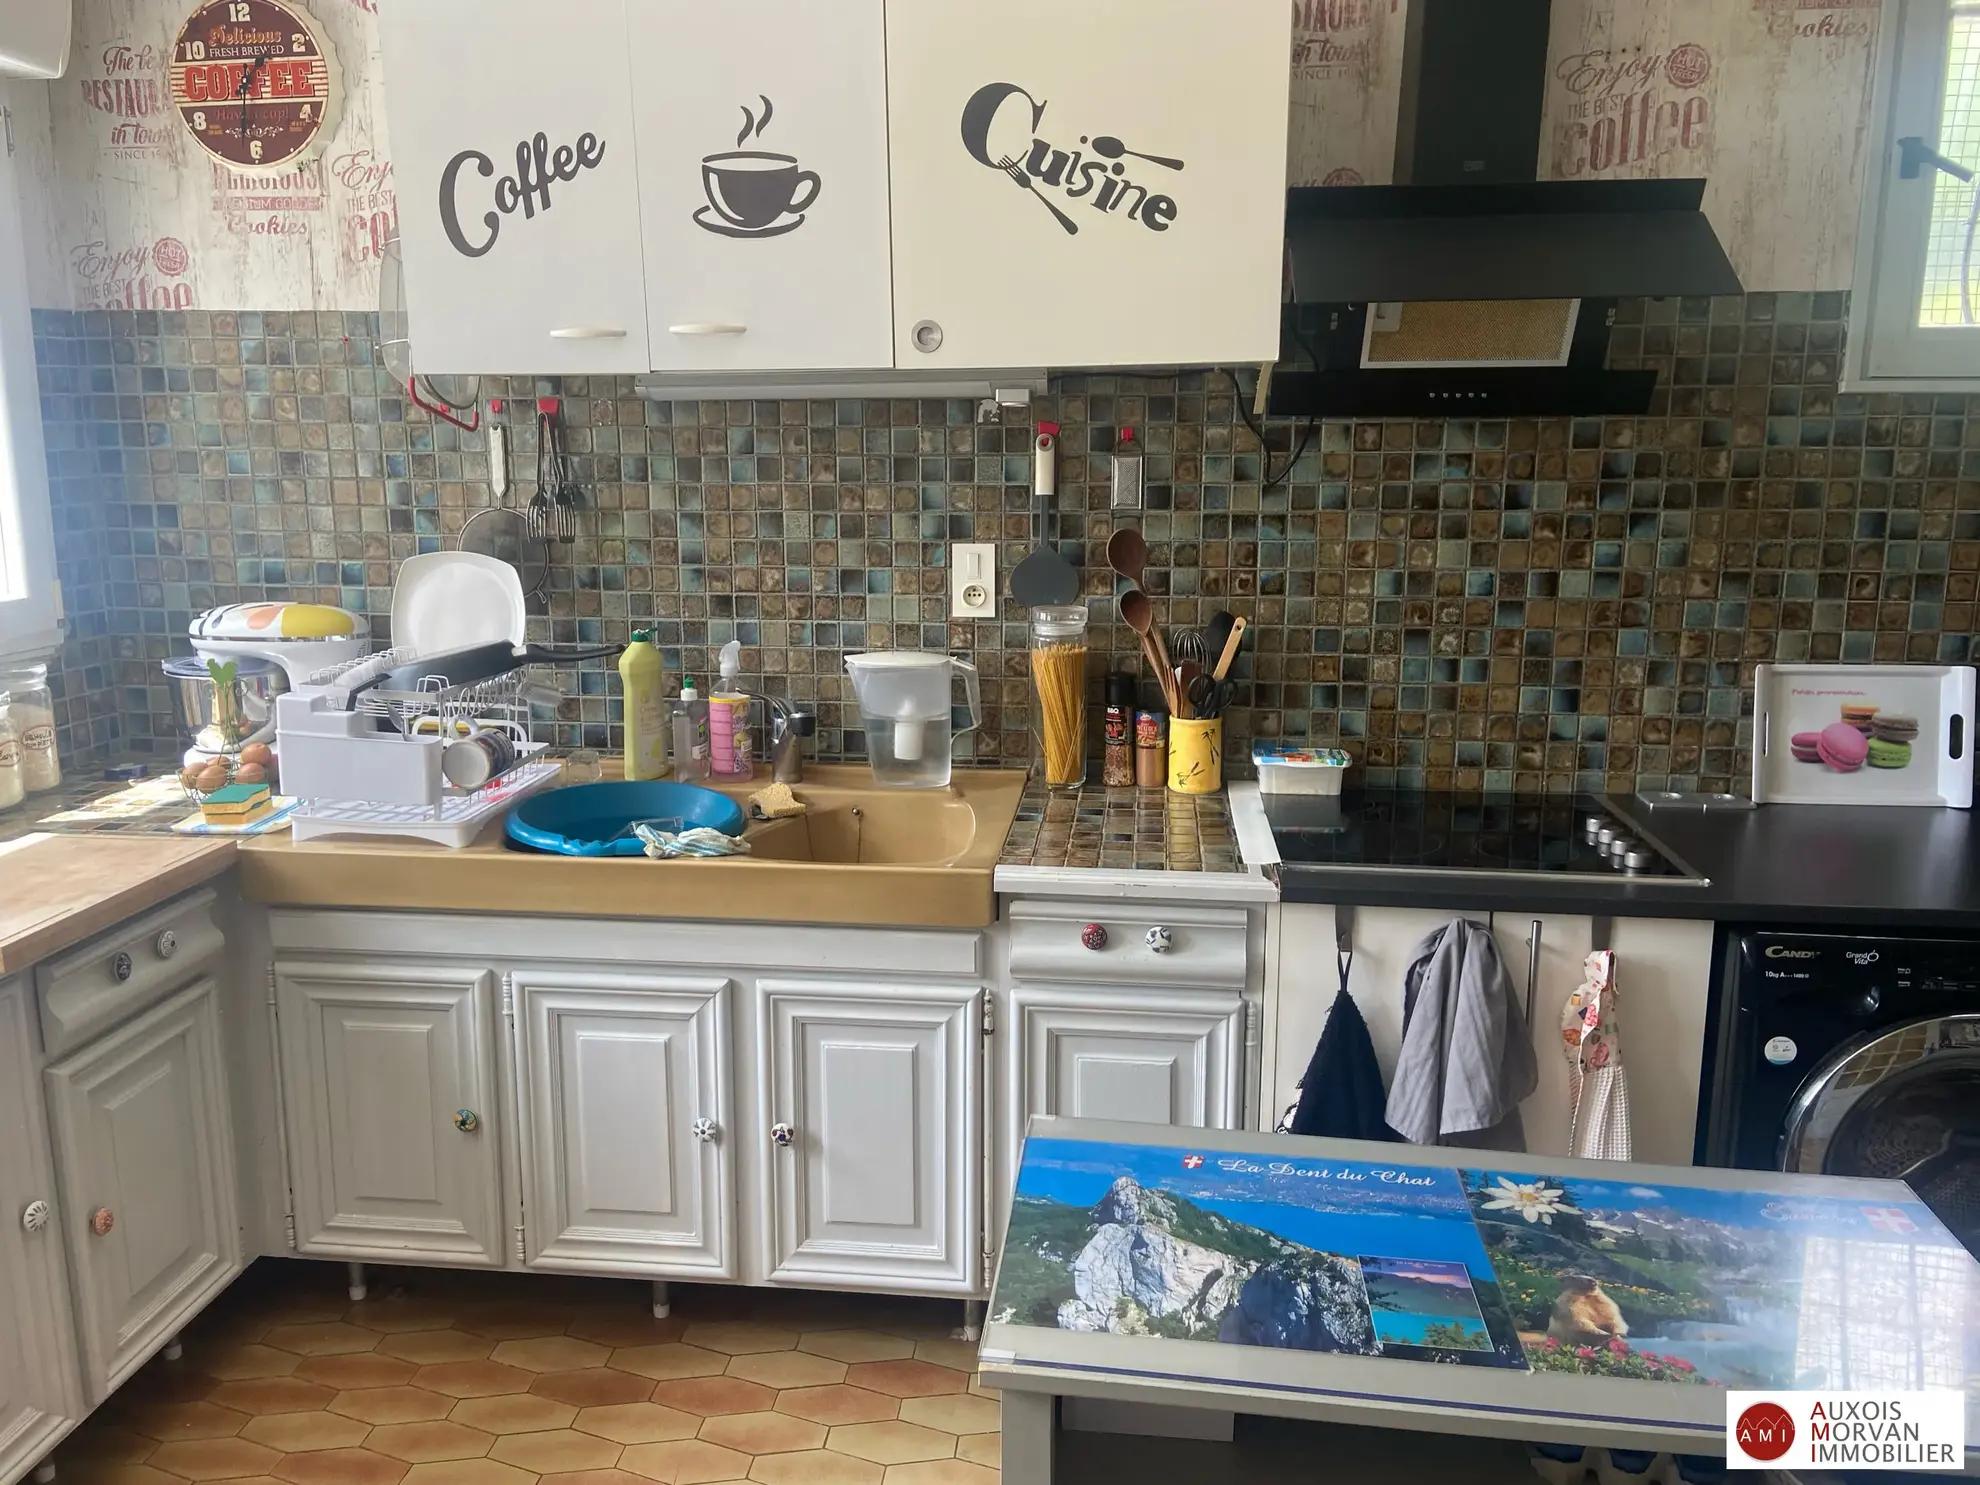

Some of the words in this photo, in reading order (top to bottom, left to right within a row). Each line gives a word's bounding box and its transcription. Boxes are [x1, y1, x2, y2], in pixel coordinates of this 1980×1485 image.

[228, 3, 251, 23] 12
[208, 25, 283, 47] Delicious
[291, 33, 306, 53] 2
[102, 46, 134, 76] The
[184, 41, 206, 61] 10
[209, 47, 240, 58] FRESH
[241, 44, 285, 56] BREWED
[1556, 49, 1665, 98] Enjoy
[193, 111, 207, 131] 8
[299, 104, 314, 123] 4
[1567, 103, 1590, 119] THE
[111, 127, 127, 145] in
[1561, 89, 1711, 178] coffee
[249, 140, 263, 160] 6
[961, 82, 1178, 232] Cuisine
[439, 131, 606, 258] Coffee
[69, 240, 151, 280] Enjoy
[1217, 1159, 1264, 1175] La
[1268, 1161, 1332, 1180] Dent
[1336, 1168, 1368, 1182] du
[1370, 1169, 1438, 1188] Chat
